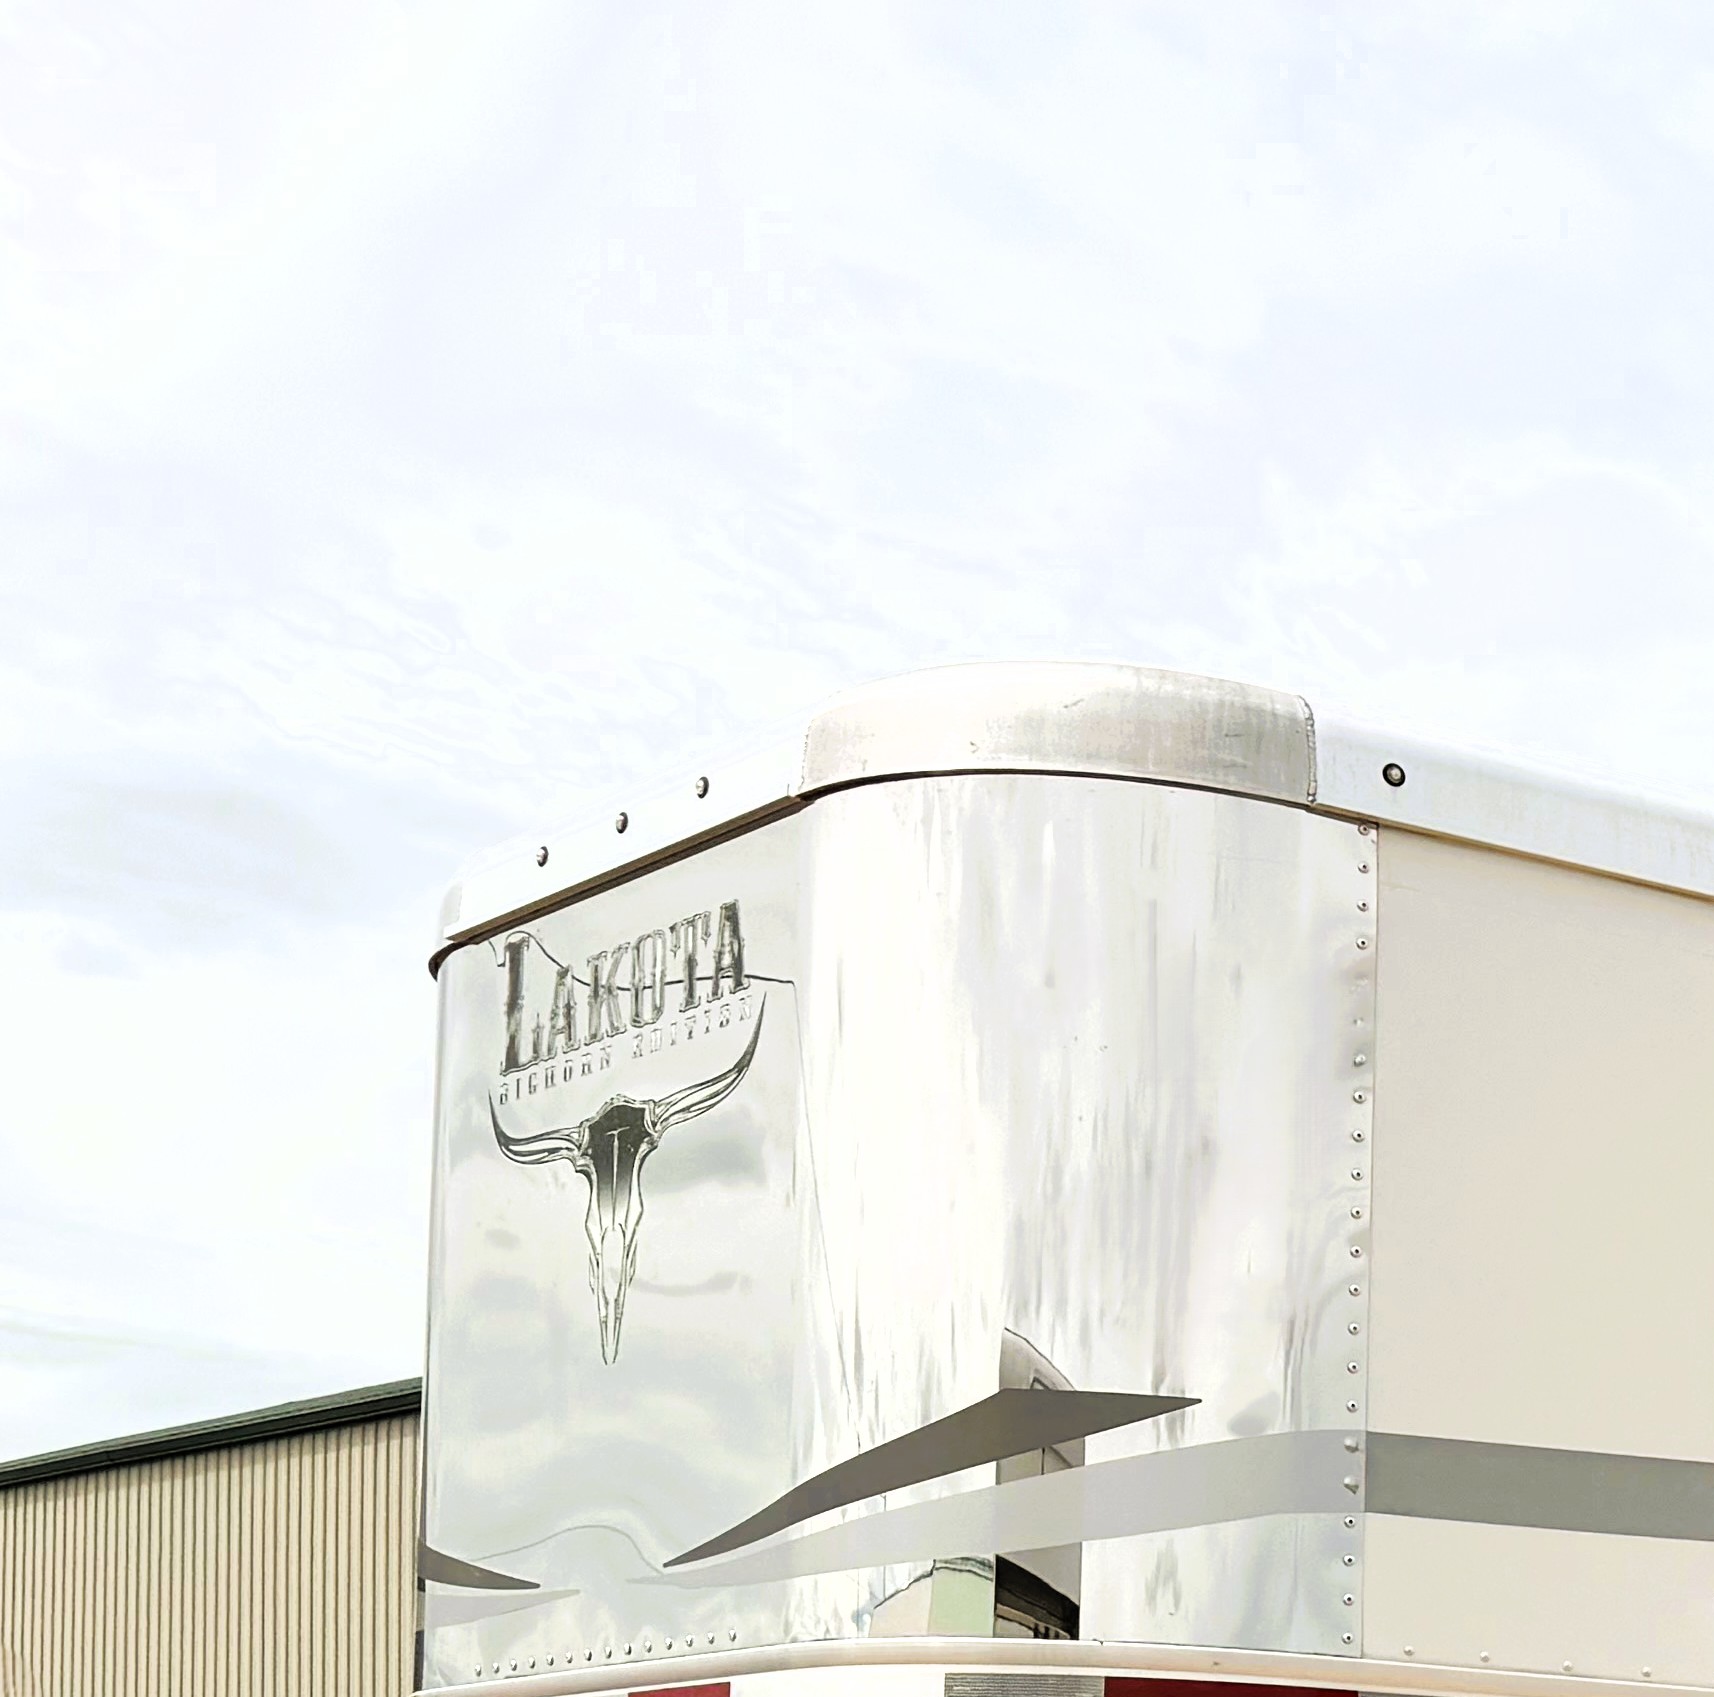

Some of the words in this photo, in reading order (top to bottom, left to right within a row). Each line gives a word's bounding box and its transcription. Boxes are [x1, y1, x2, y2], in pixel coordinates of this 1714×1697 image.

[499, 1045, 612, 1106] BIGHORN
[632, 994, 753, 1059] EDITION
[500, 899, 751, 1076] LAKOTA
